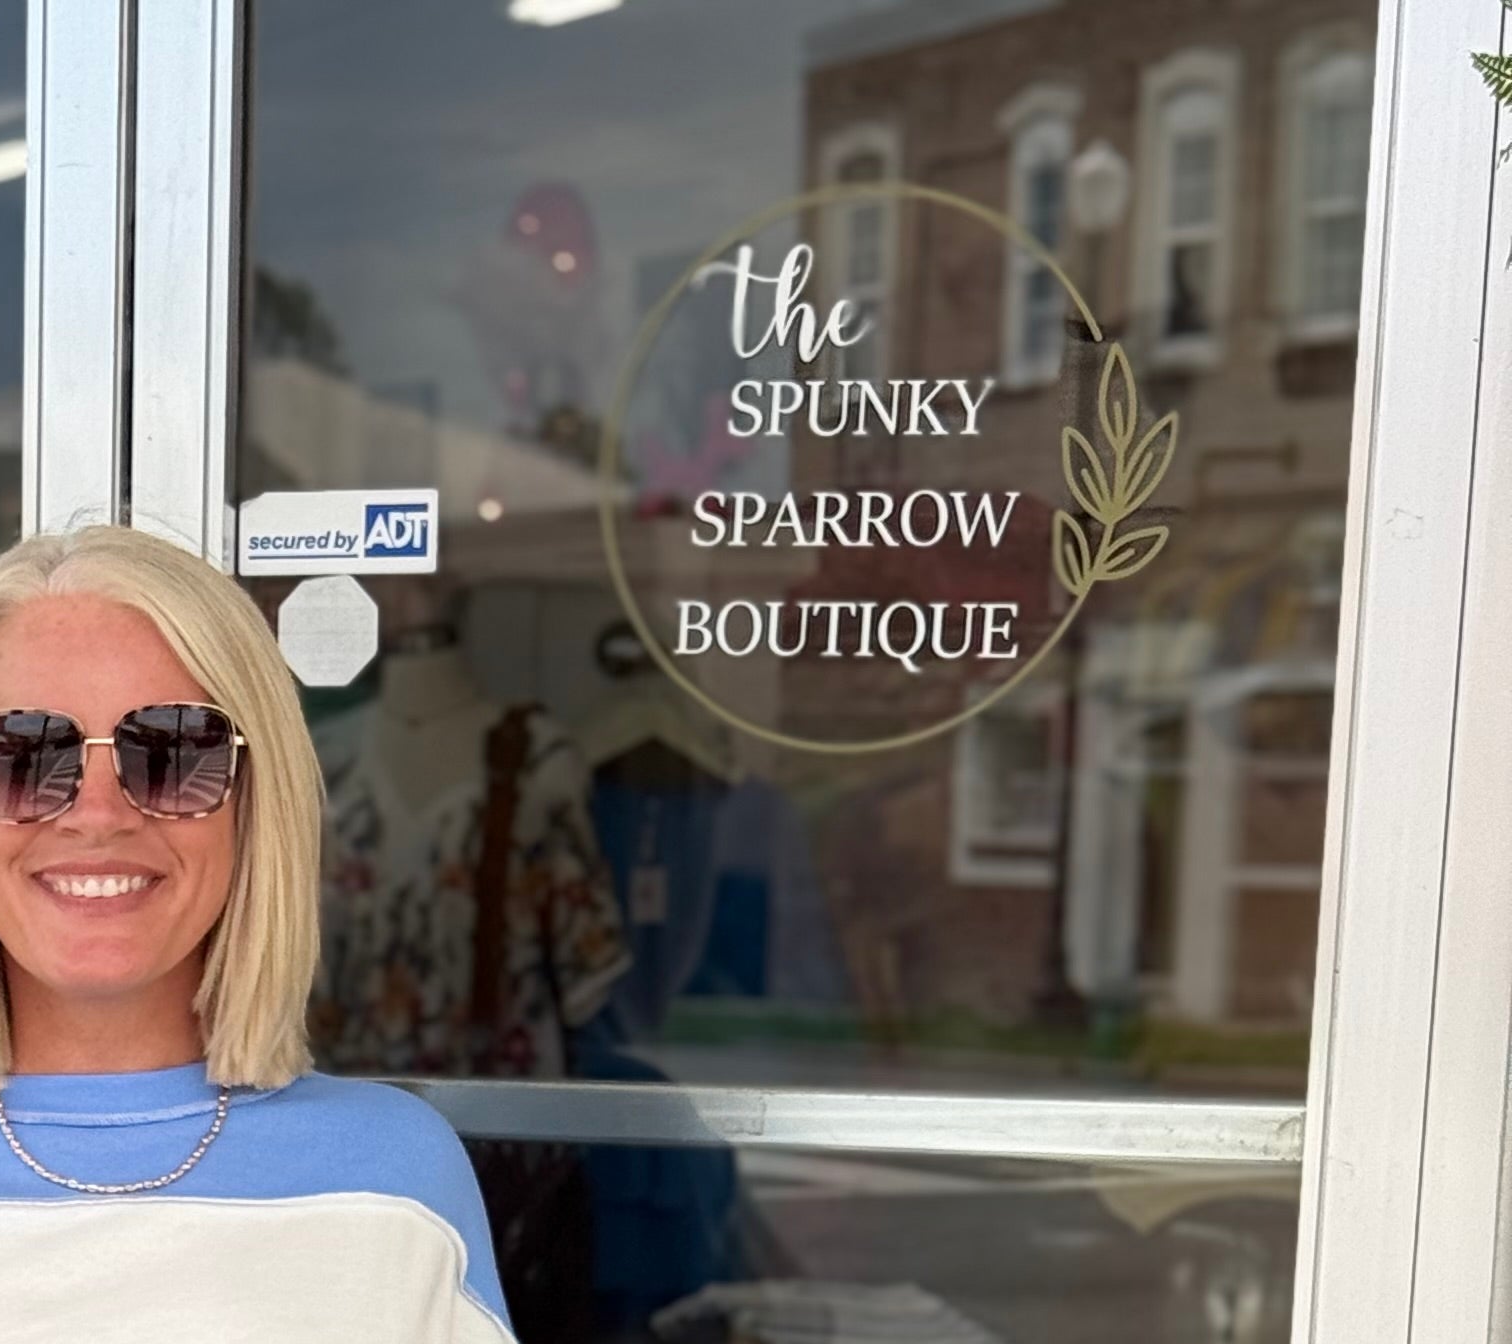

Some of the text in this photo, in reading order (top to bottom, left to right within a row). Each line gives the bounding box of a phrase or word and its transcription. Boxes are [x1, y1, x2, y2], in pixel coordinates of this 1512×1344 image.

[692, 242, 874, 363] the
[726, 377, 995, 438] SPUNKY
[247, 511, 429, 552] secured by ADT
[690, 488, 1021, 548] SPARROW
[674, 600, 1020, 674] BOUTIQUE
